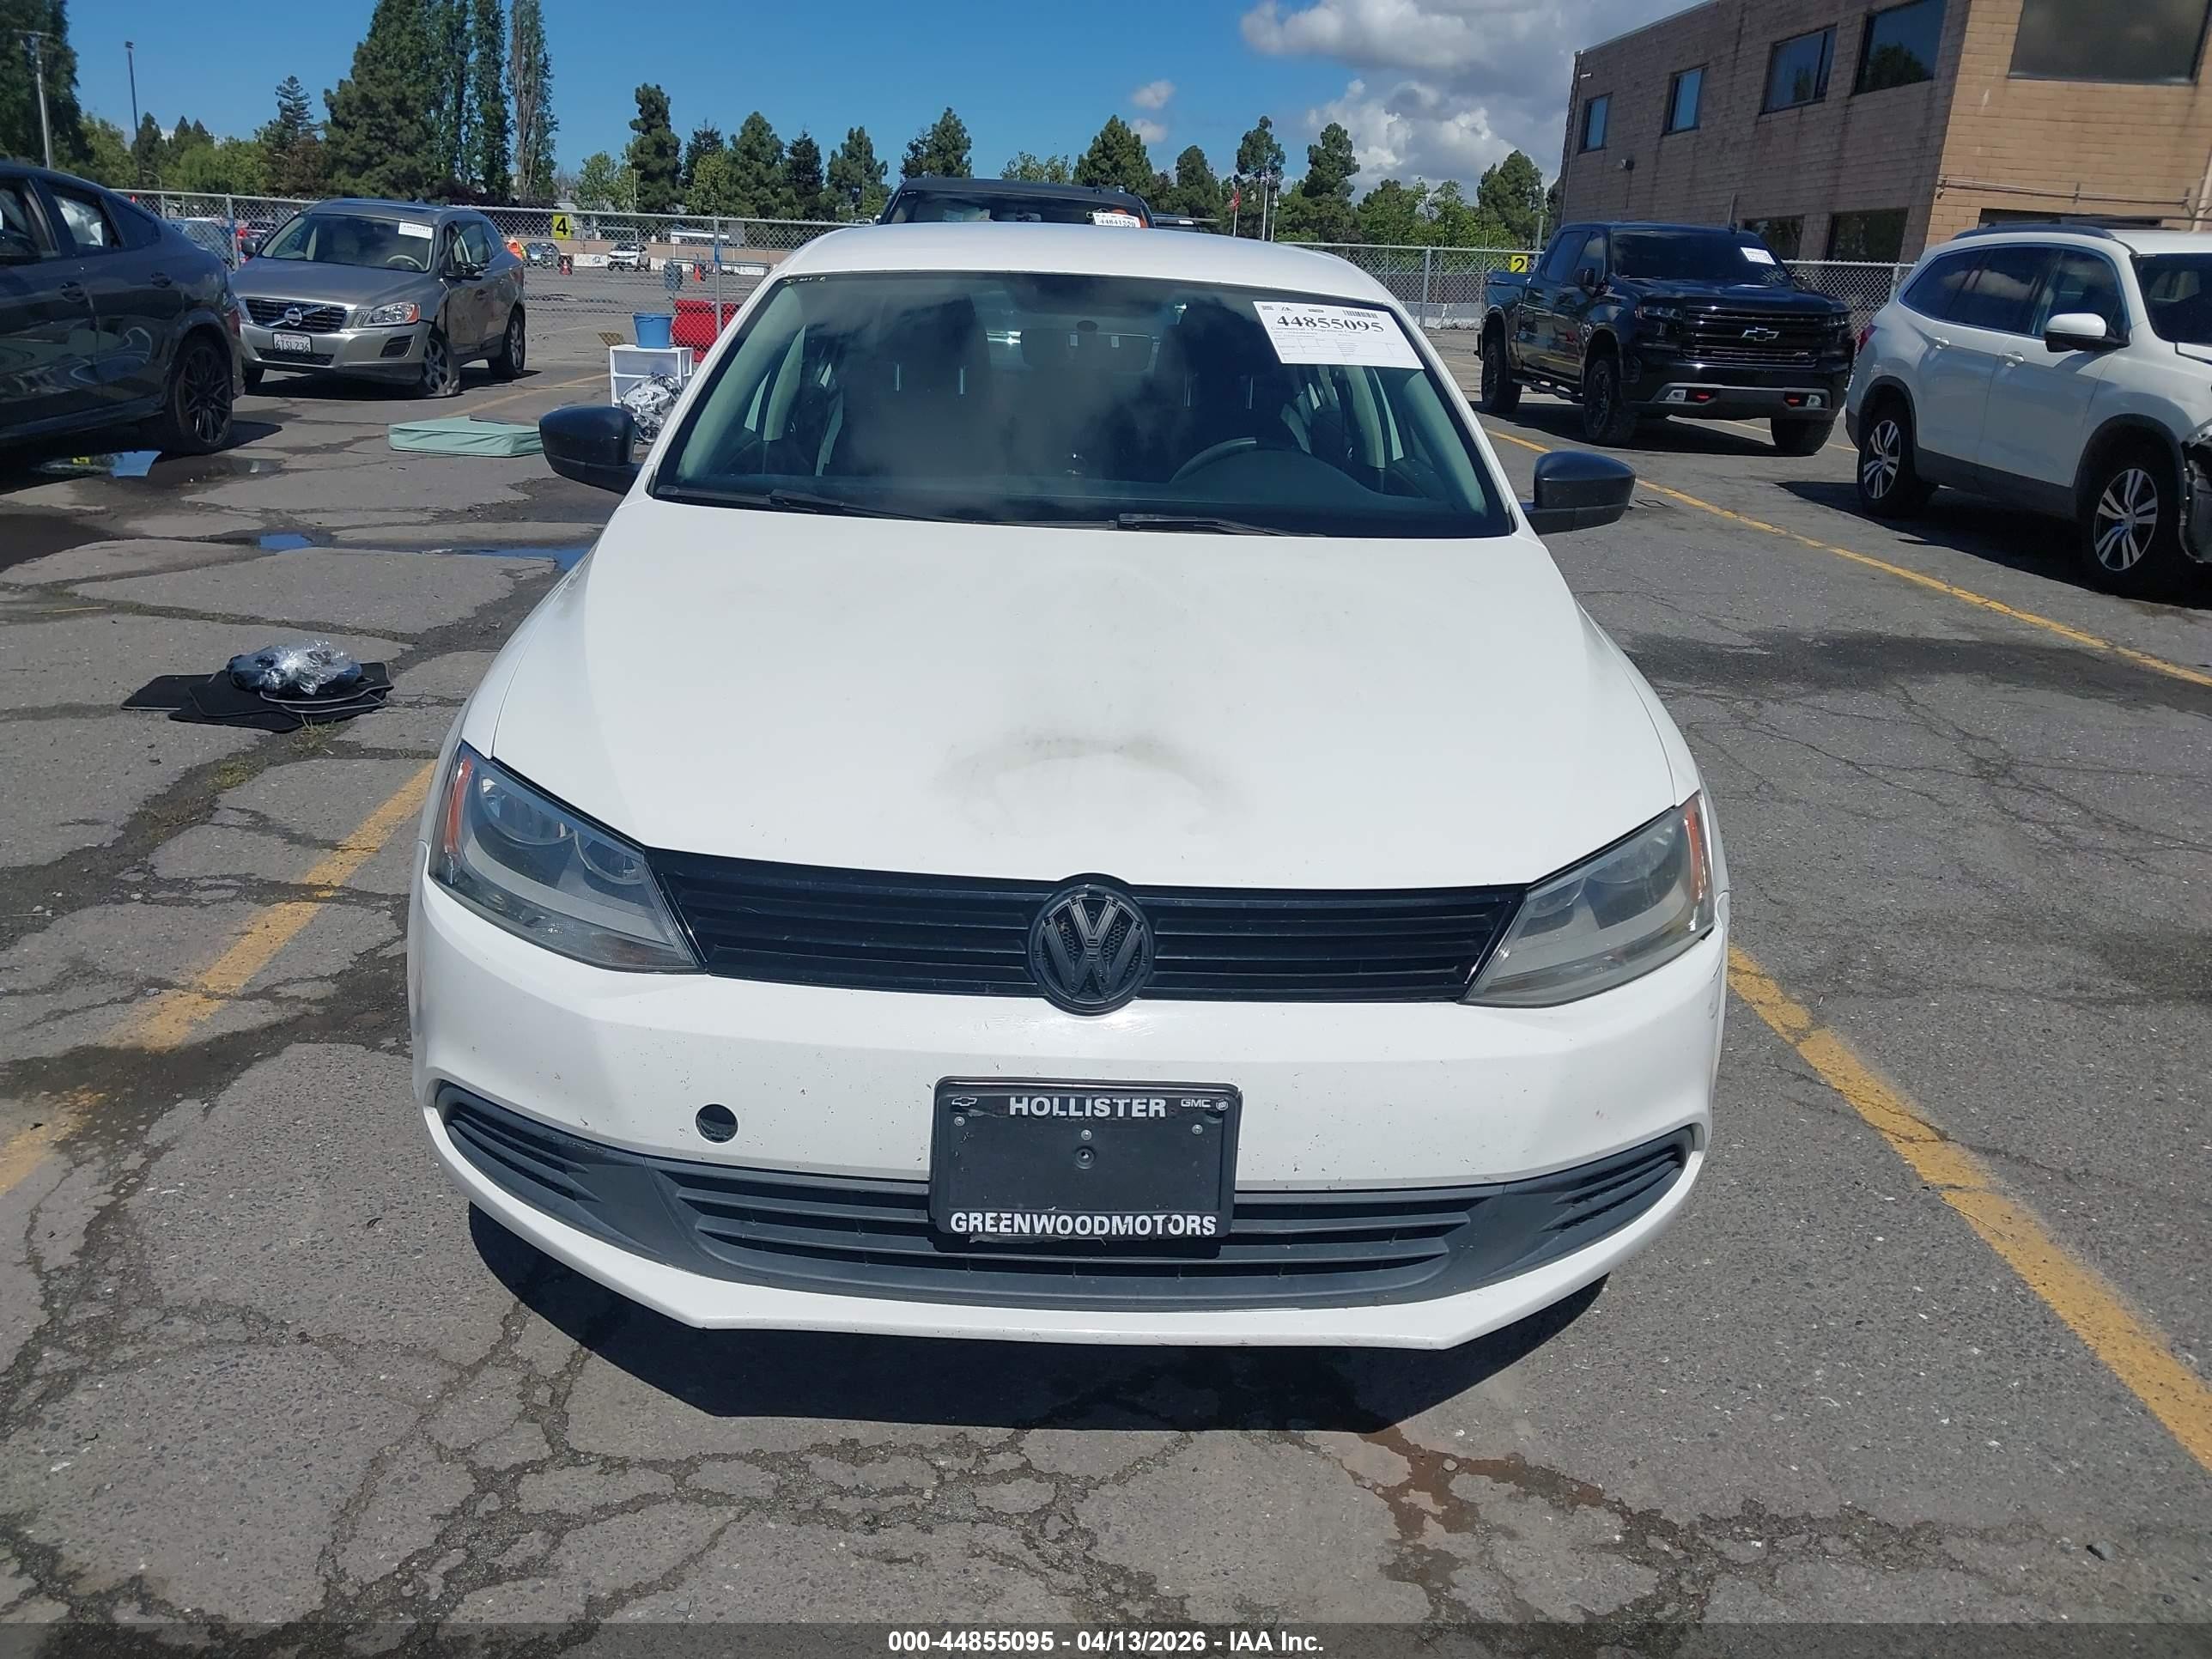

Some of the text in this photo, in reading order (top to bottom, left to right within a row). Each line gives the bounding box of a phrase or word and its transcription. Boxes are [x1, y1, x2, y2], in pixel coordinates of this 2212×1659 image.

[556, 217, 568, 235] 4
[1514, 257, 1525, 272] 2
[1276, 315, 1384, 333] 44855095
[1009, 1096, 1167, 1118] HOLLISTER
[1180, 1097, 1212, 1109] GMC
[951, 1212, 1217, 1237] GREENWOODMOTORS
